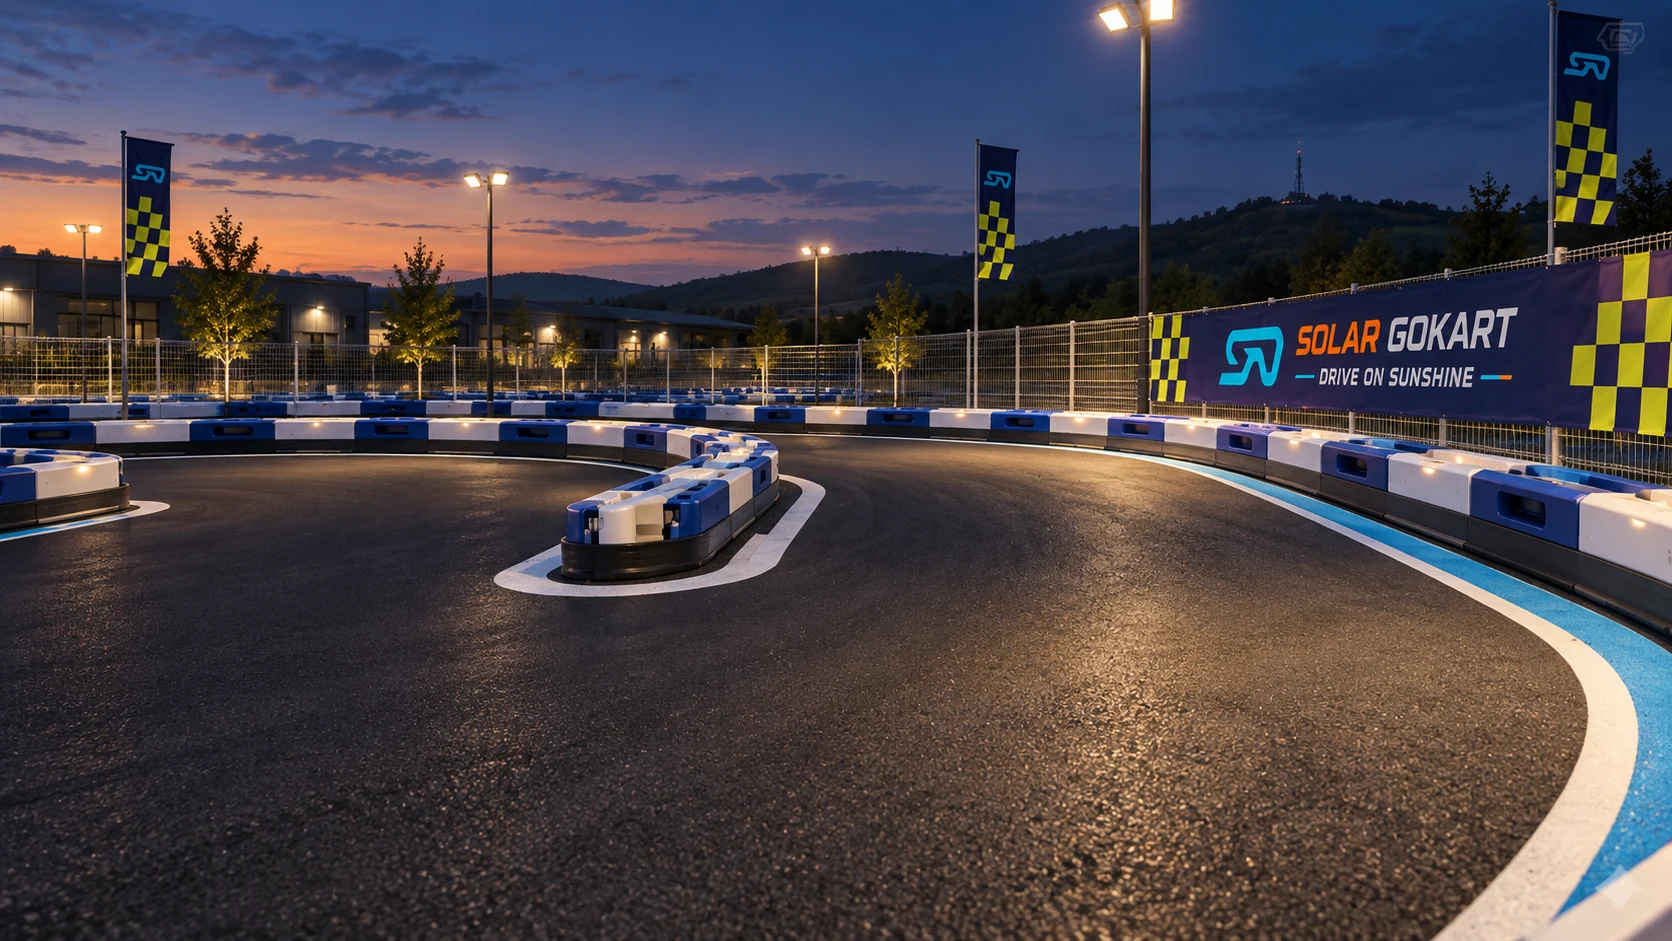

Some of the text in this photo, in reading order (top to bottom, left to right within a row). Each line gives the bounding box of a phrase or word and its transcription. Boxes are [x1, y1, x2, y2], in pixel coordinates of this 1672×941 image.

[1296, 307, 1518, 356] SOLAR GOKART
[1318, 366, 1474, 388] DRIVE ON SUNSHINE
